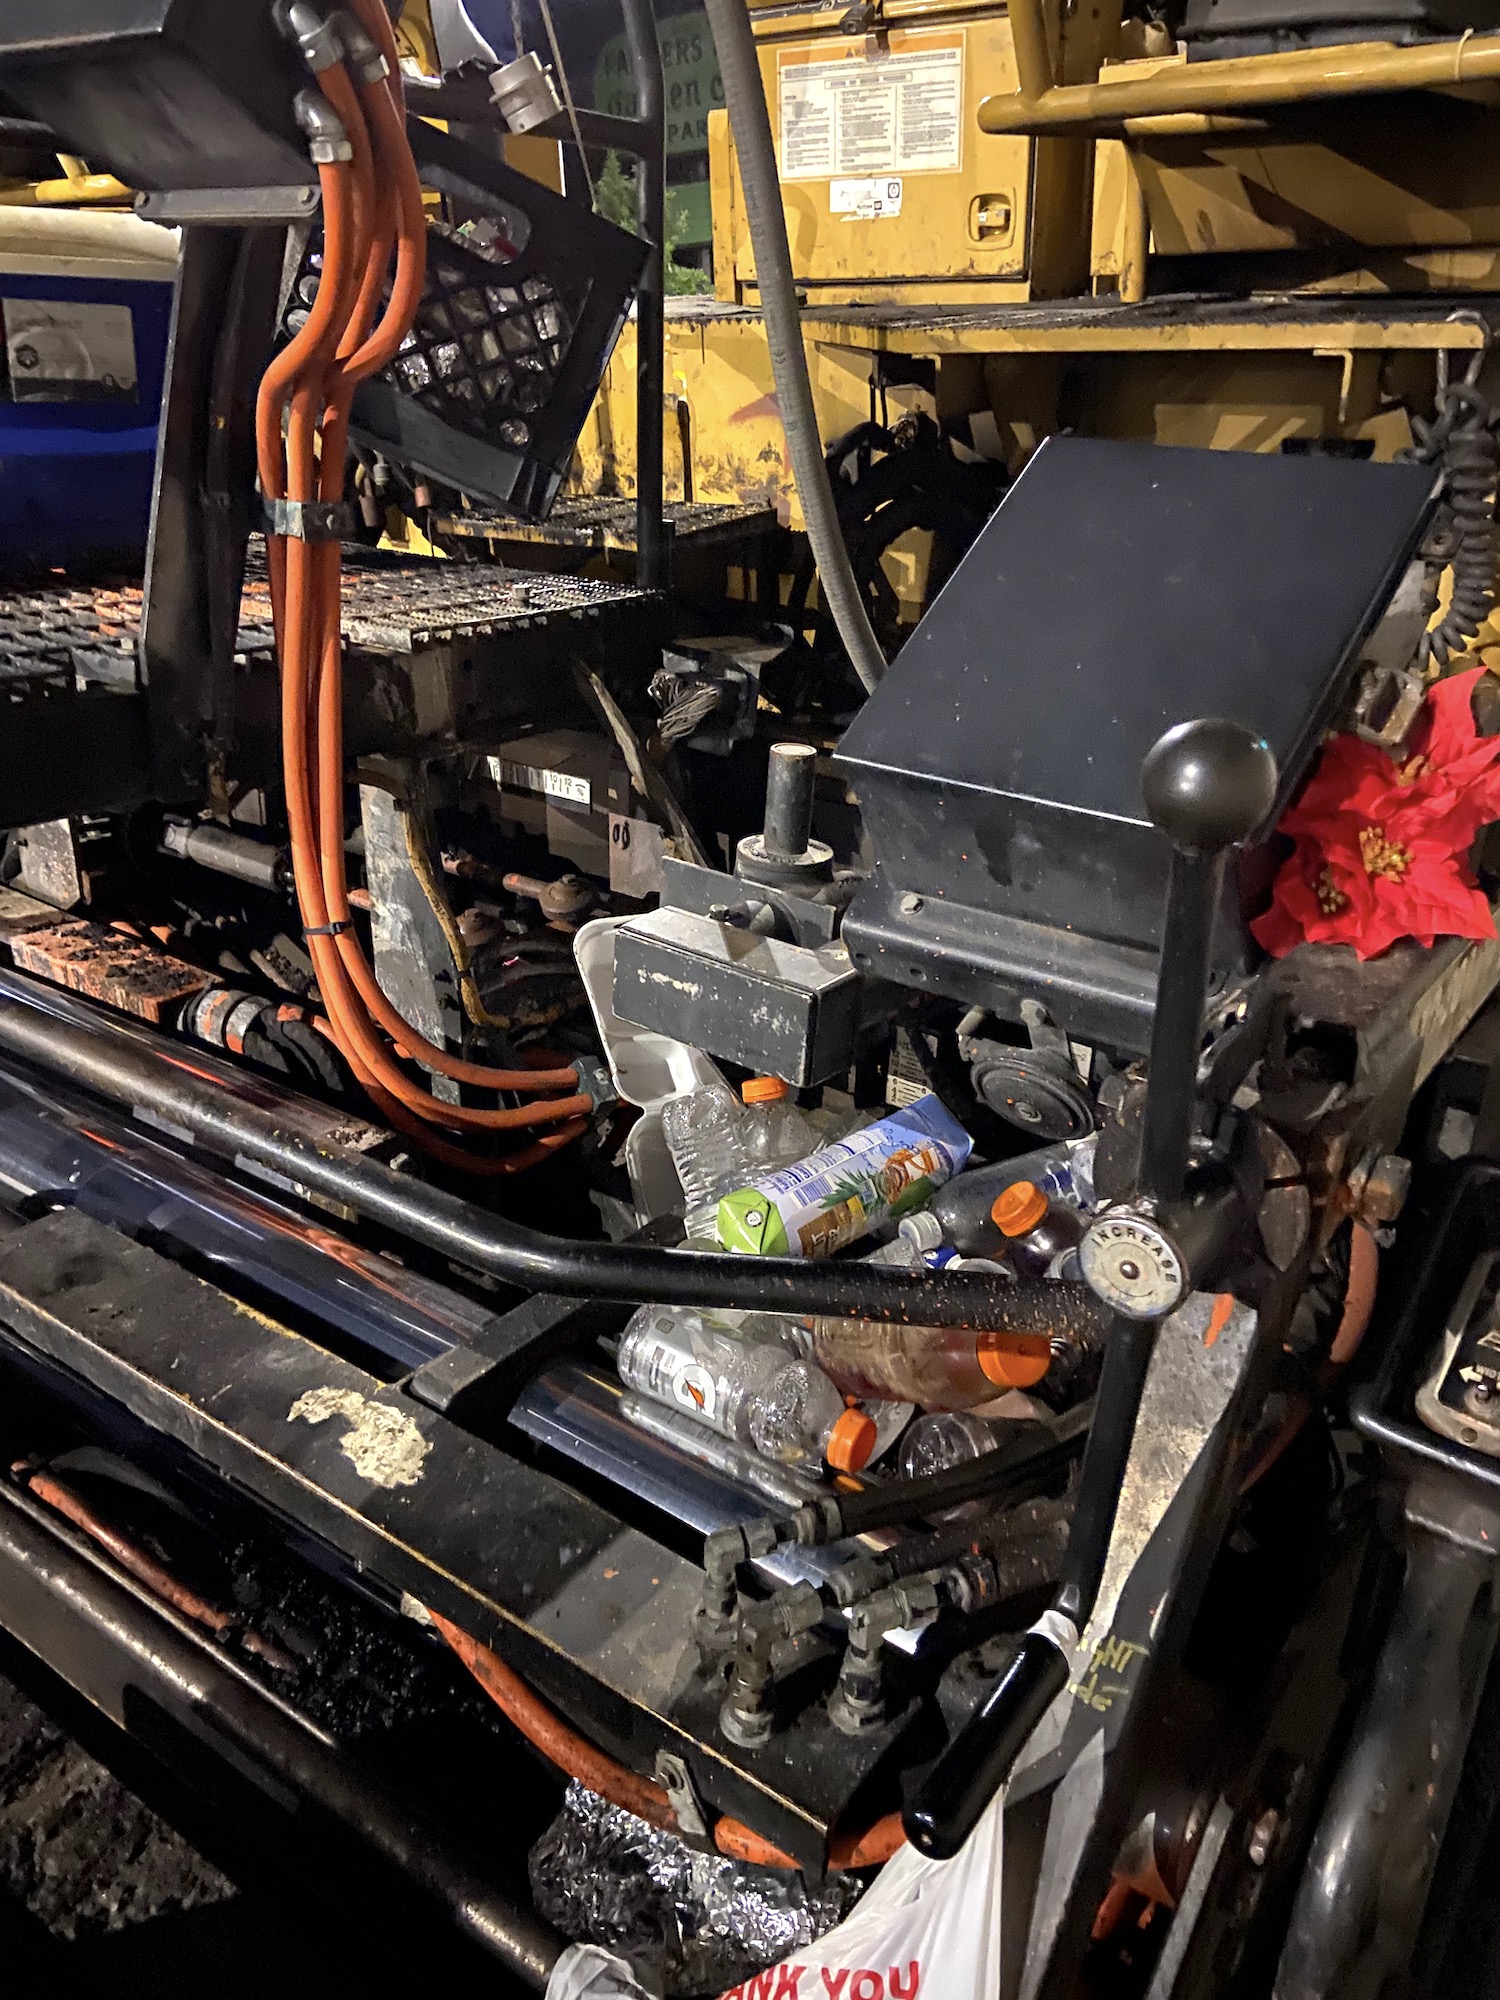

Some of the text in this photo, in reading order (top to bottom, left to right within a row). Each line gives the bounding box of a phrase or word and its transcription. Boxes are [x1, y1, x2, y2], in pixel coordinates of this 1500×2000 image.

[604, 34, 702, 78] FAERS
[550, 774, 558, 784] 10
[564, 777, 573, 787] 12
[1091, 1226, 1178, 1283] INCREASE
[821, 1960, 918, 2000] YOU
